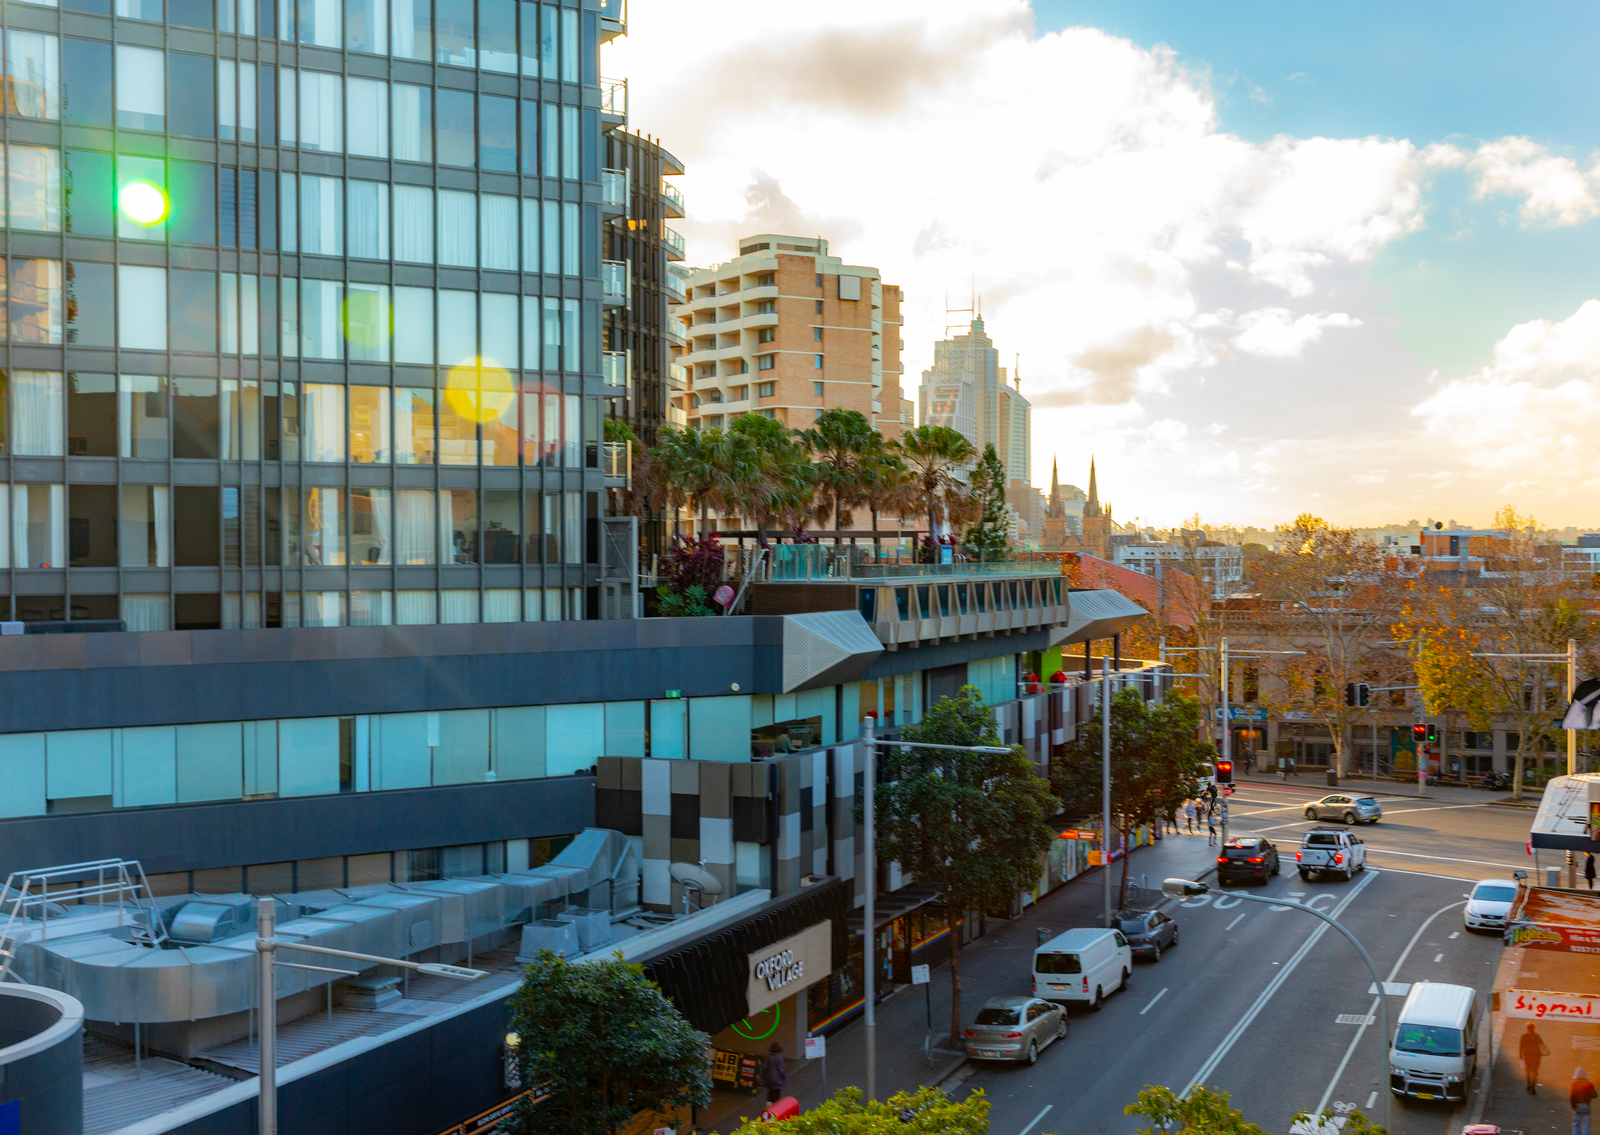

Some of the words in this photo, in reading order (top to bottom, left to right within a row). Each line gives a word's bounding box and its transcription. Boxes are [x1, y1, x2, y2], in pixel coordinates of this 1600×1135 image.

[756, 949, 793, 979] OXFORD
[767, 961, 804, 991] VILLAGE
[1514, 995, 1592, 1018] Signal
[718, 1053, 737, 1065] JB
